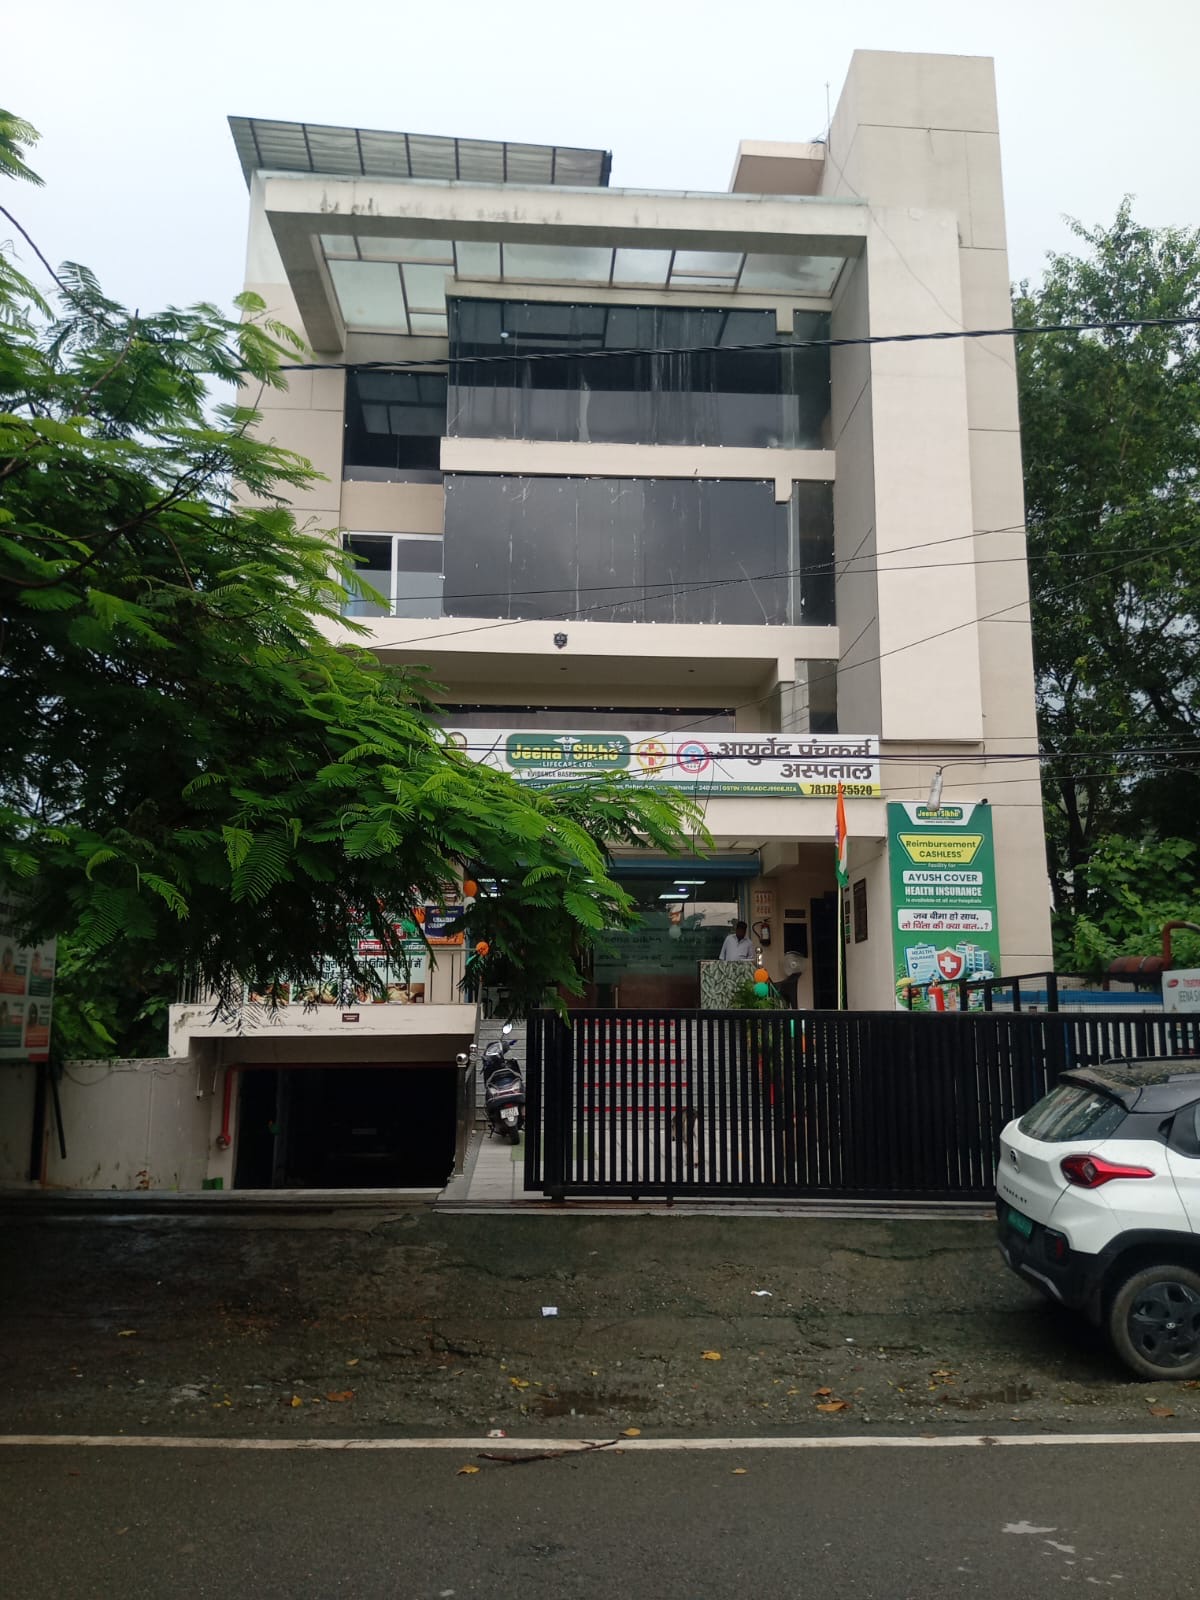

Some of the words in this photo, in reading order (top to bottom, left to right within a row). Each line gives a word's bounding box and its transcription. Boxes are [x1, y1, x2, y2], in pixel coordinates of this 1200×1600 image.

[511, 743, 562, 760] Jeena
[572, 743, 620, 761] Sikho
[780, 762, 873, 780] अस्पताल
[810, 784, 837, 796] 78178
[842, 784, 873, 796] 25520
[905, 839, 976, 848] Reimbursement
[908, 873, 942, 882] AYUSH
[943, 873, 978, 882] COVER
[905, 886, 935, 896] HEALTH
[935, 886, 982, 897] INSURANCE
